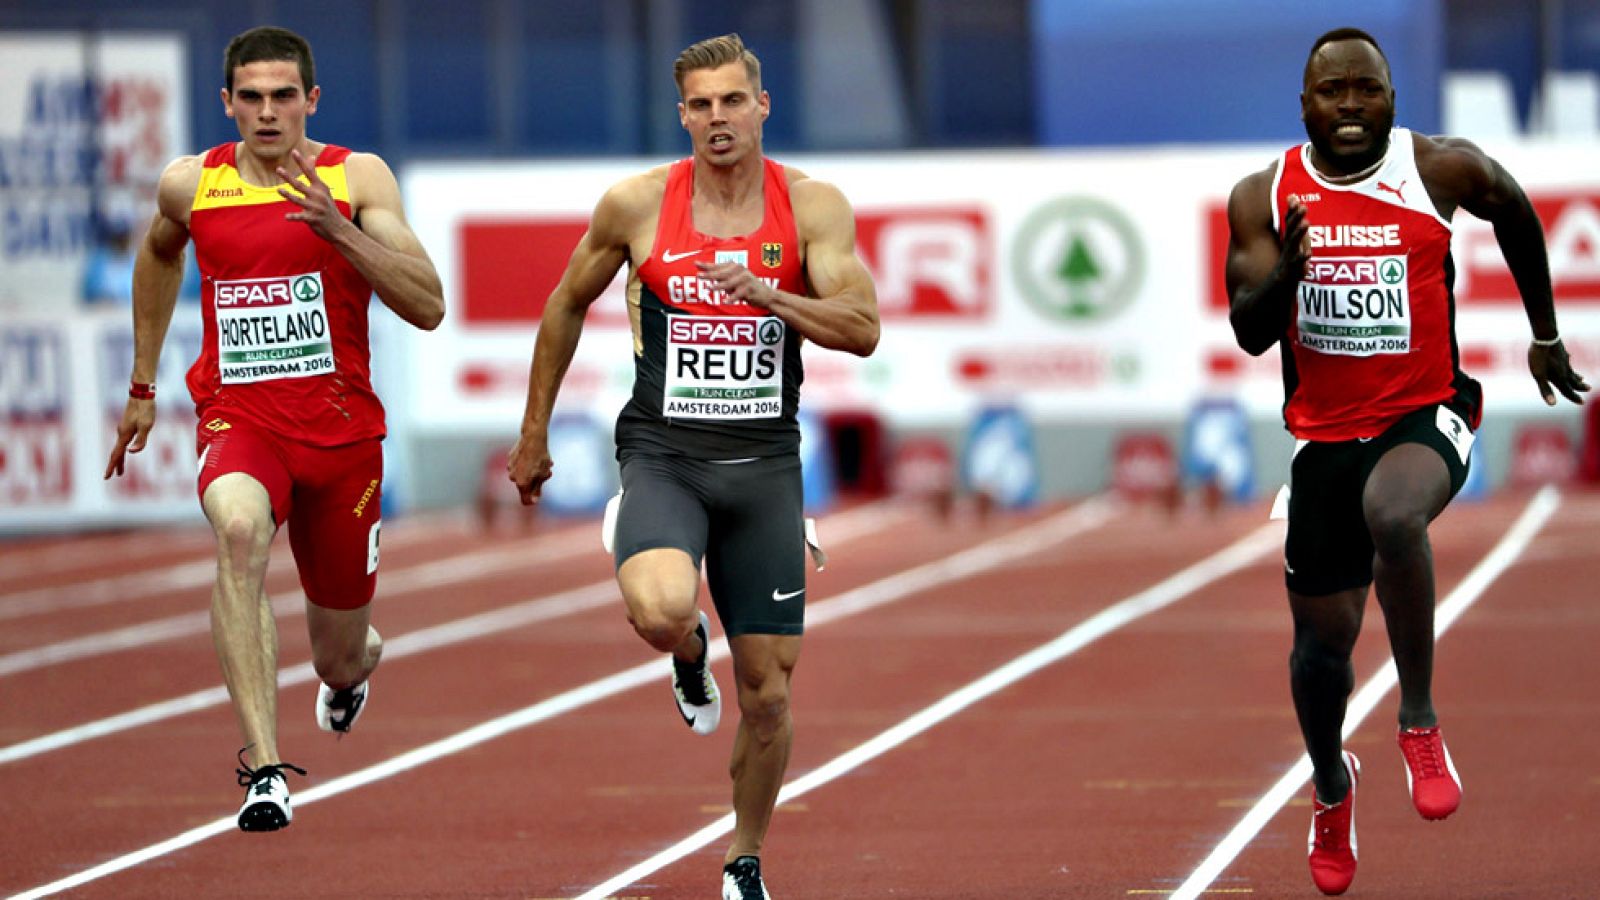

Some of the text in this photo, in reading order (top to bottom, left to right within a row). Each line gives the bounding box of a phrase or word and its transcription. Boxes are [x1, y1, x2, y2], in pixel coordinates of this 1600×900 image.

[1308, 224, 1402, 248] SUISSE
[218, 283, 290, 306] SPAR
[1302, 285, 1404, 320] WILSON
[220, 309, 325, 347] HORTELANO
[672, 321, 755, 342] SPAR
[270, 347, 303, 359] CLEAN
[1302, 335, 1408, 352] AMSTERDAM 2016
[222, 357, 332, 379] AMSTERDAM 2016
[677, 347, 776, 381] REUS
[724, 388, 757, 399] CLEAN
[667, 402, 780, 415] AMSTERDAM 2016
